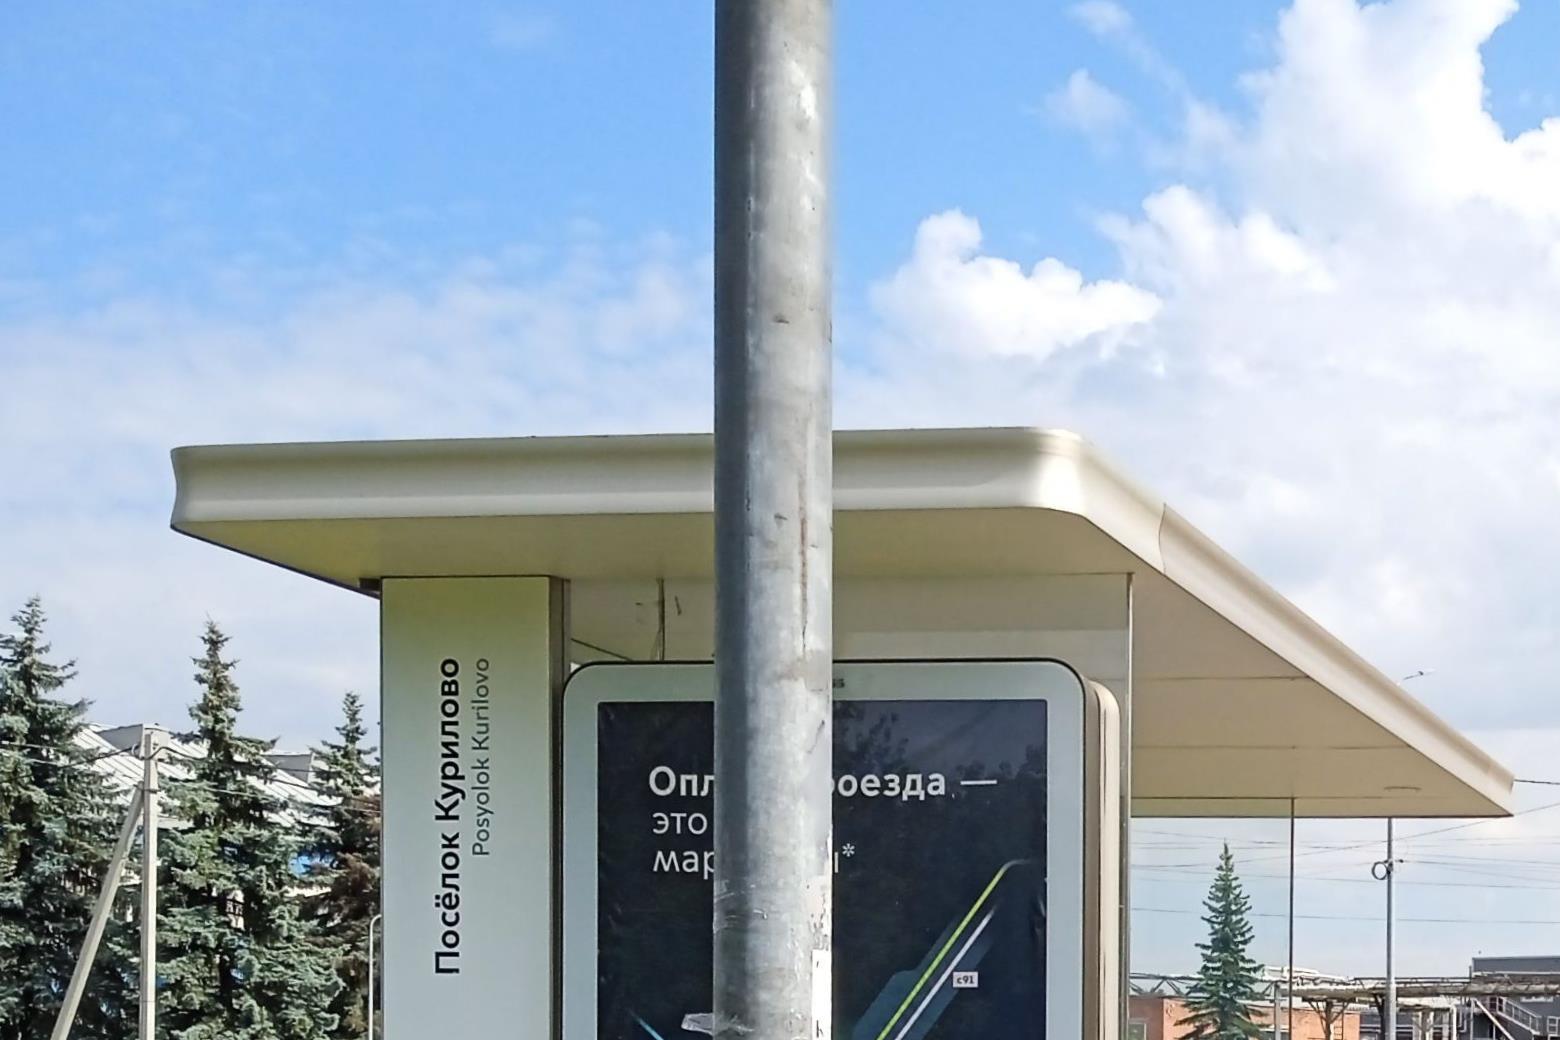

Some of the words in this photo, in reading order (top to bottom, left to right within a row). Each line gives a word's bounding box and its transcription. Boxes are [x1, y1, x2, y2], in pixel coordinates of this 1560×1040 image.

[434, 658, 466, 821] Курилово
[471, 658, 490, 751] Kurilovo
[471, 758, 494, 856] Posyolok
[649, 765, 716, 797] Опл
[832, 773, 946, 801] оезда
[652, 812, 708, 835] это
[434, 832, 461, 974] Посёлок
